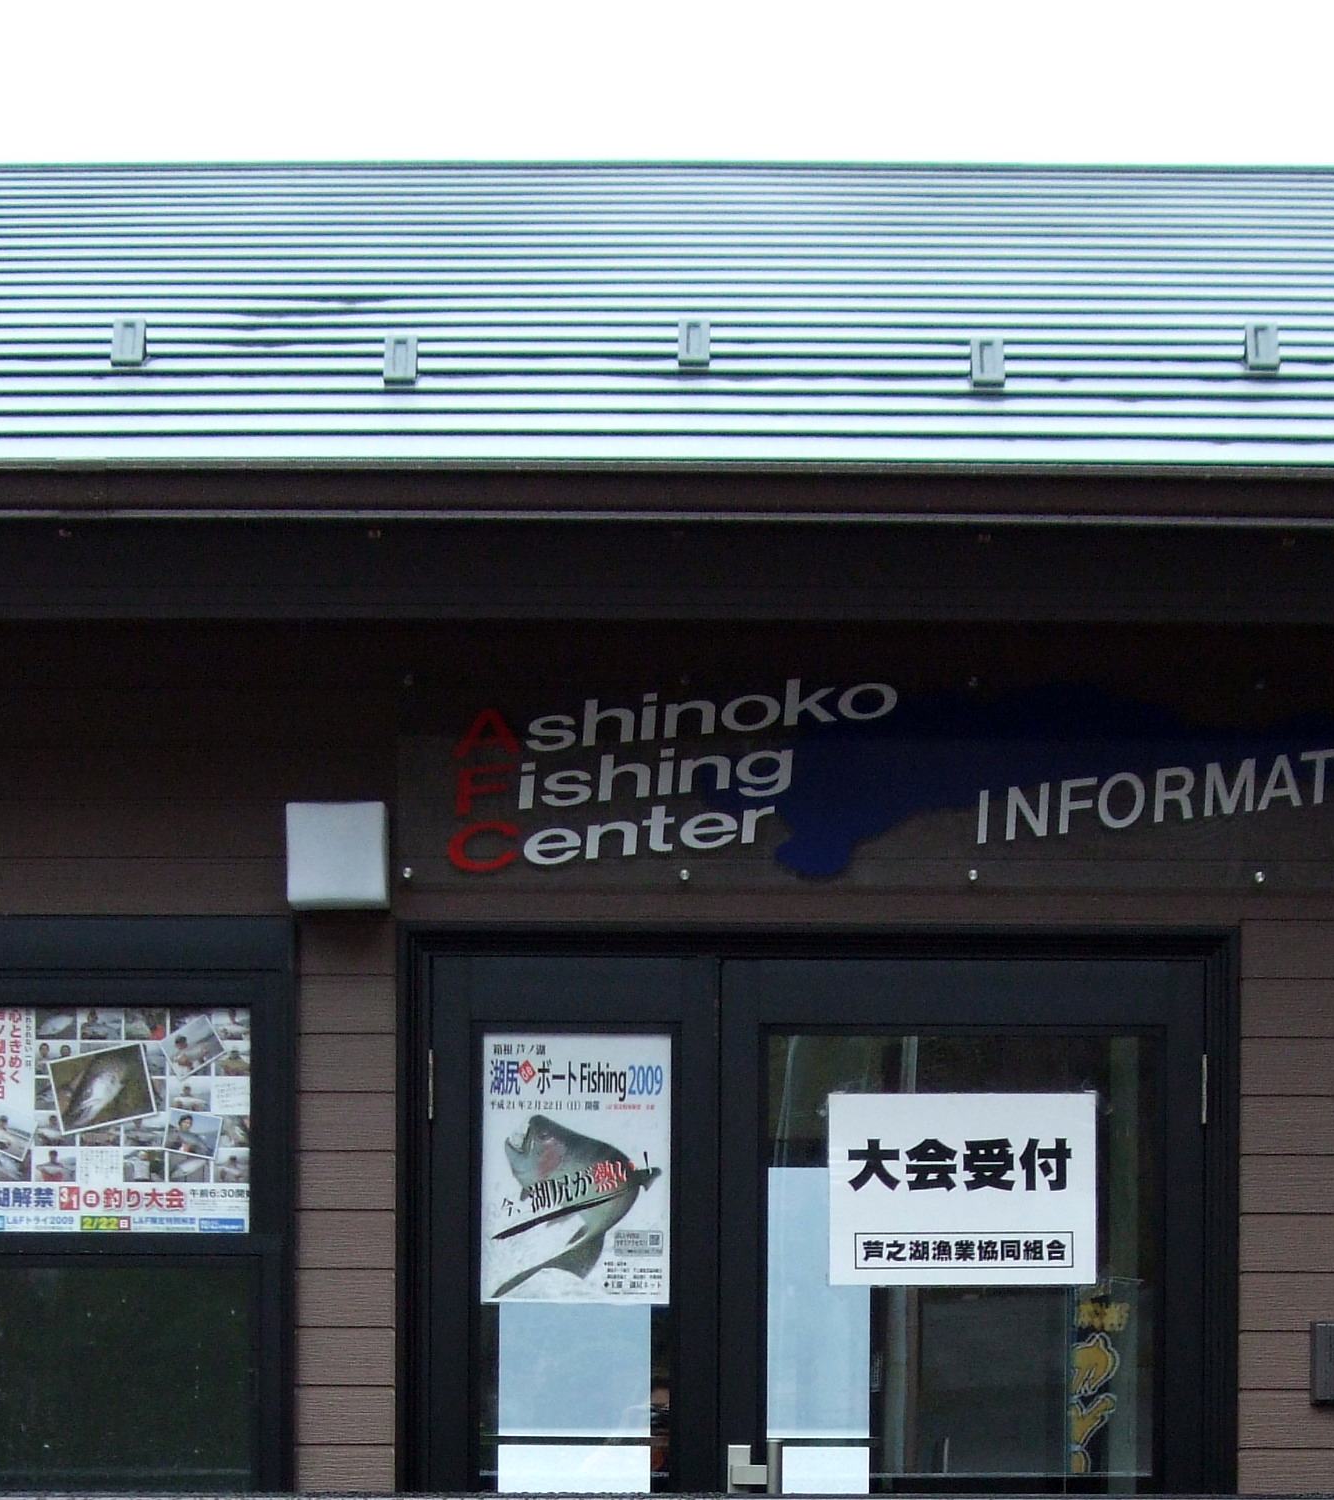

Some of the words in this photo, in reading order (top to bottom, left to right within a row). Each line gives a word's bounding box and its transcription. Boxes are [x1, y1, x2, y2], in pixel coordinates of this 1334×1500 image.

[452, 680, 898, 759] Ashinoko
[455, 750, 794, 816] Fishing
[448, 805, 775, 874] Center
[580, 1062, 627, 1102] Fishing
[628, 1065, 663, 1096] 2009
[848, 1137, 1072, 1191] 大会受付
[82, 1217, 118, 1229] 2/22
[103, 1188, 185, 1211] 釣り大会
[862, 1239, 1067, 1262] 芦之湖漁業協同組合
